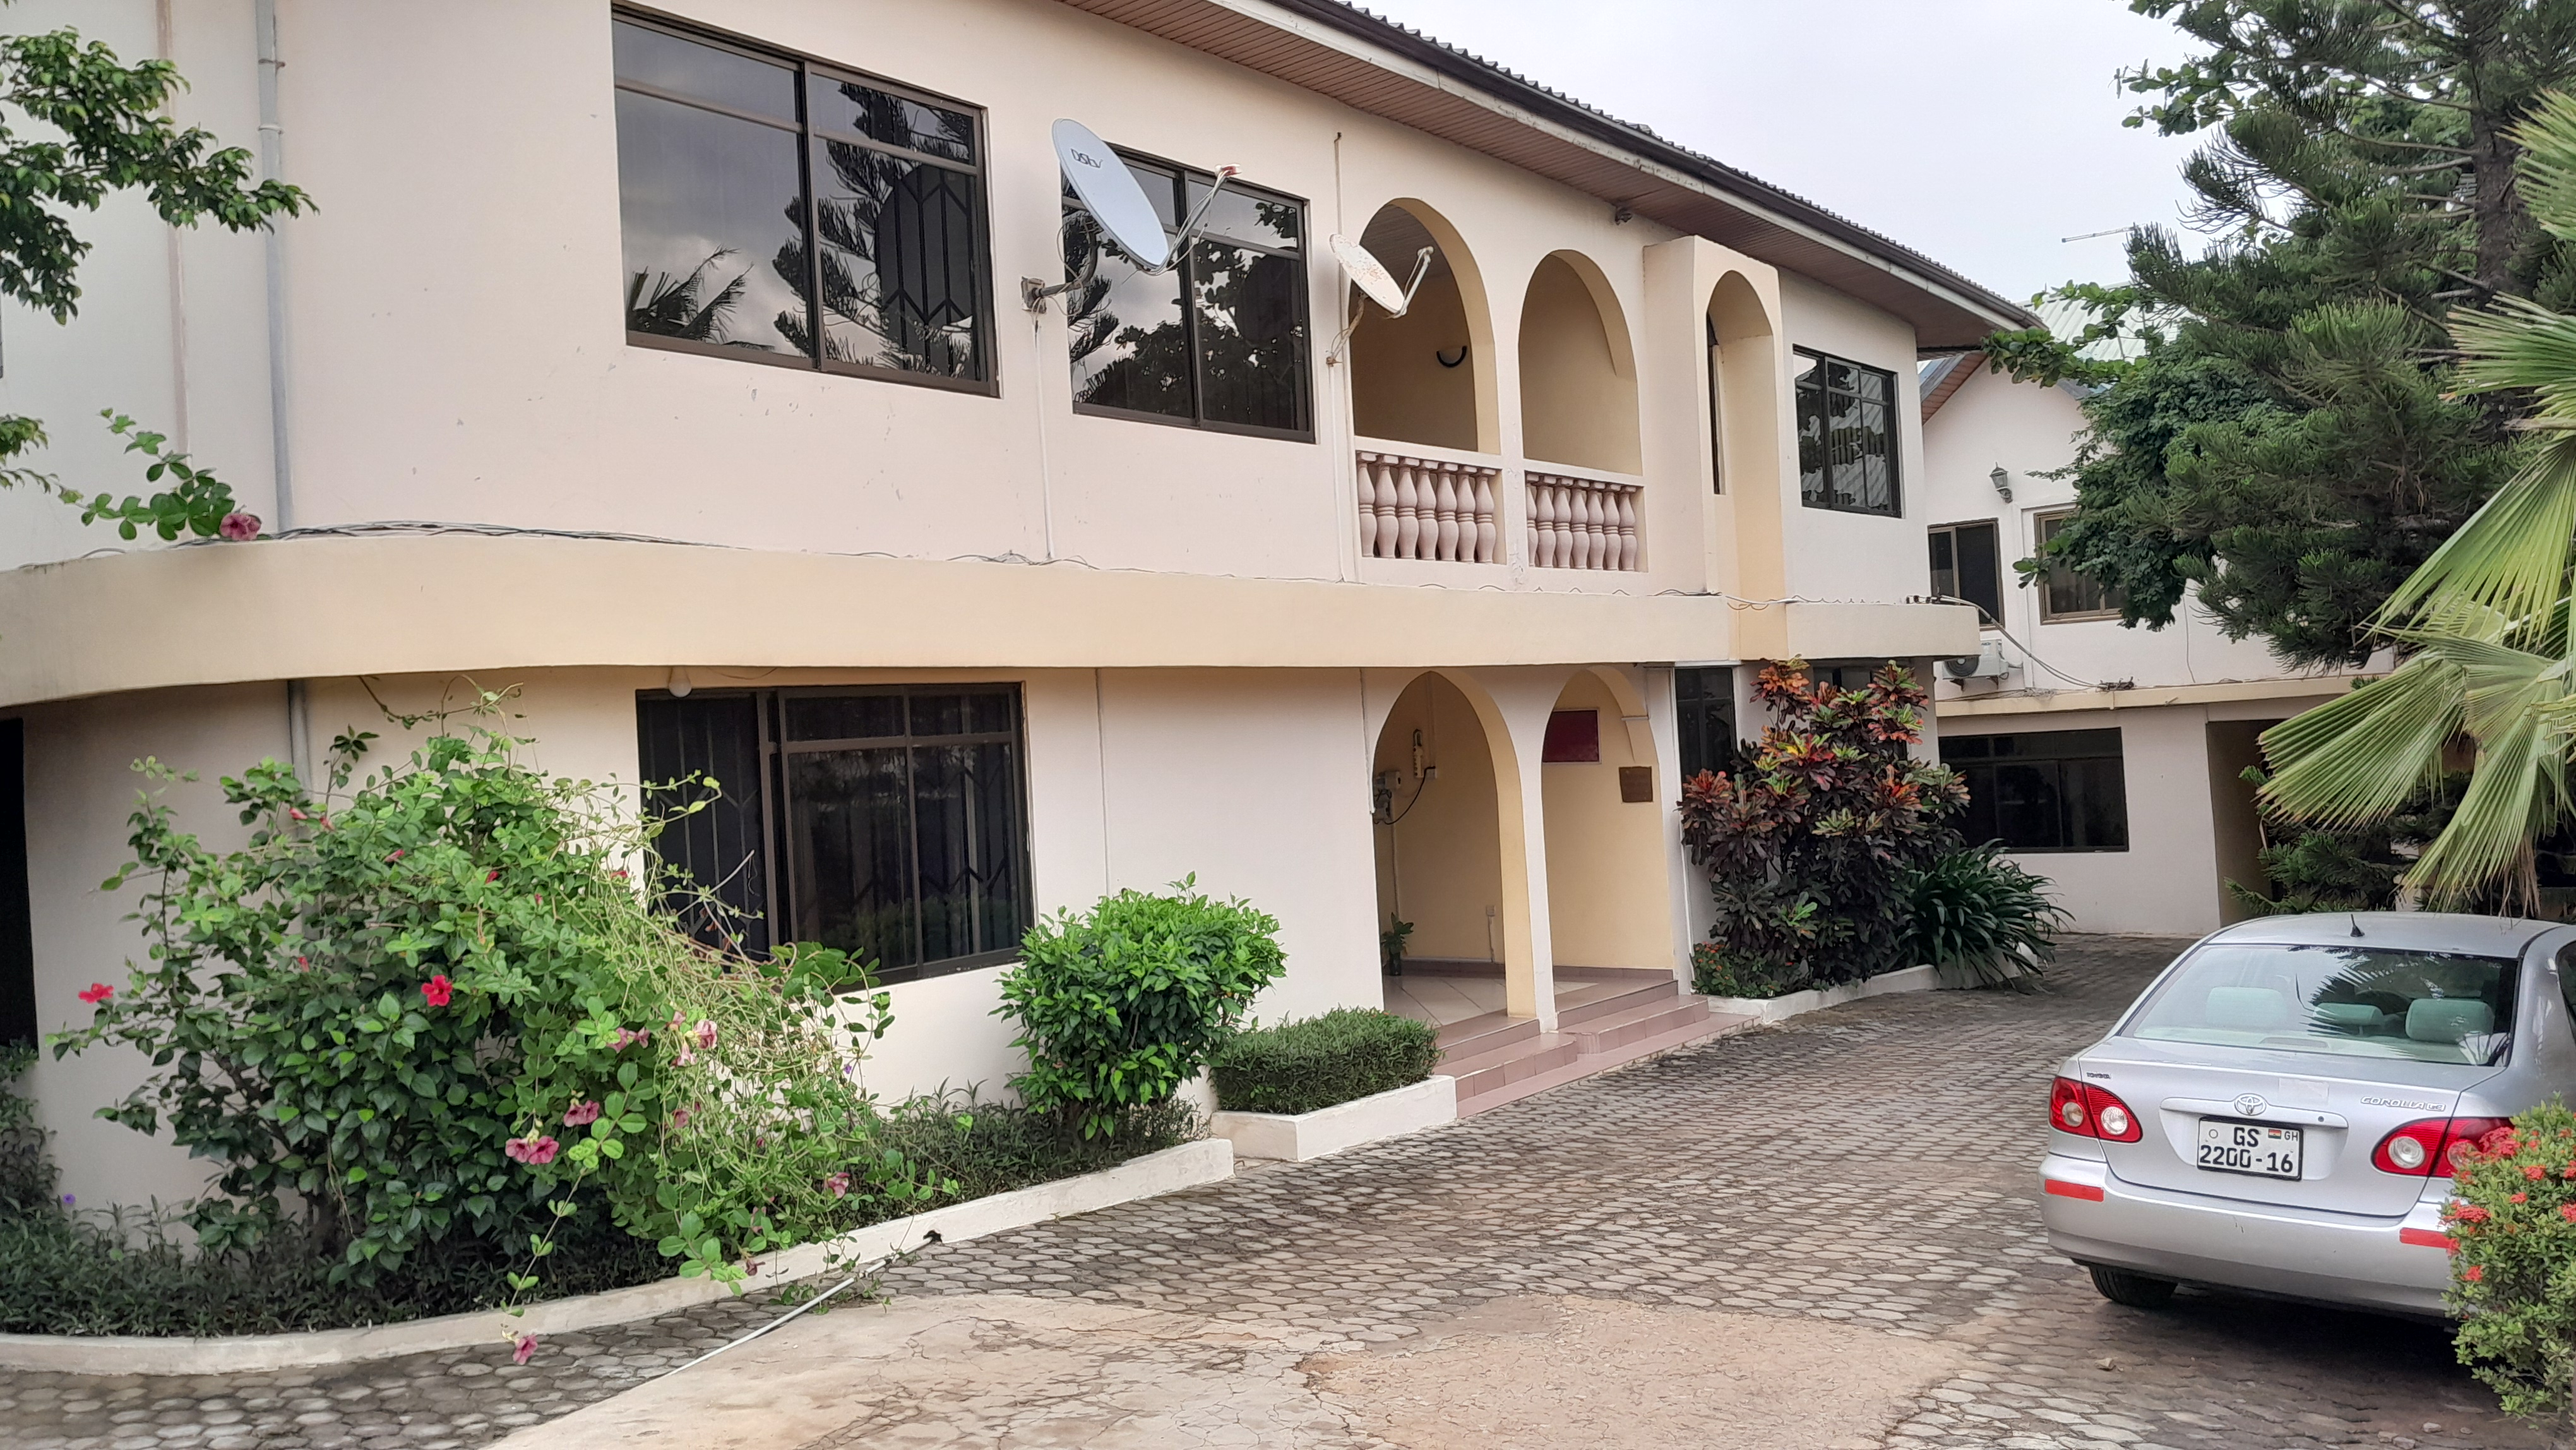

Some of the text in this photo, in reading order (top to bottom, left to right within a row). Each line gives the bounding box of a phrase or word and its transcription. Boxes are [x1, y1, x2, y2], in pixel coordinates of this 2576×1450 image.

[2361, 1096, 2424, 1110] COROLLA
[2233, 1126, 2298, 1147] GS GH
